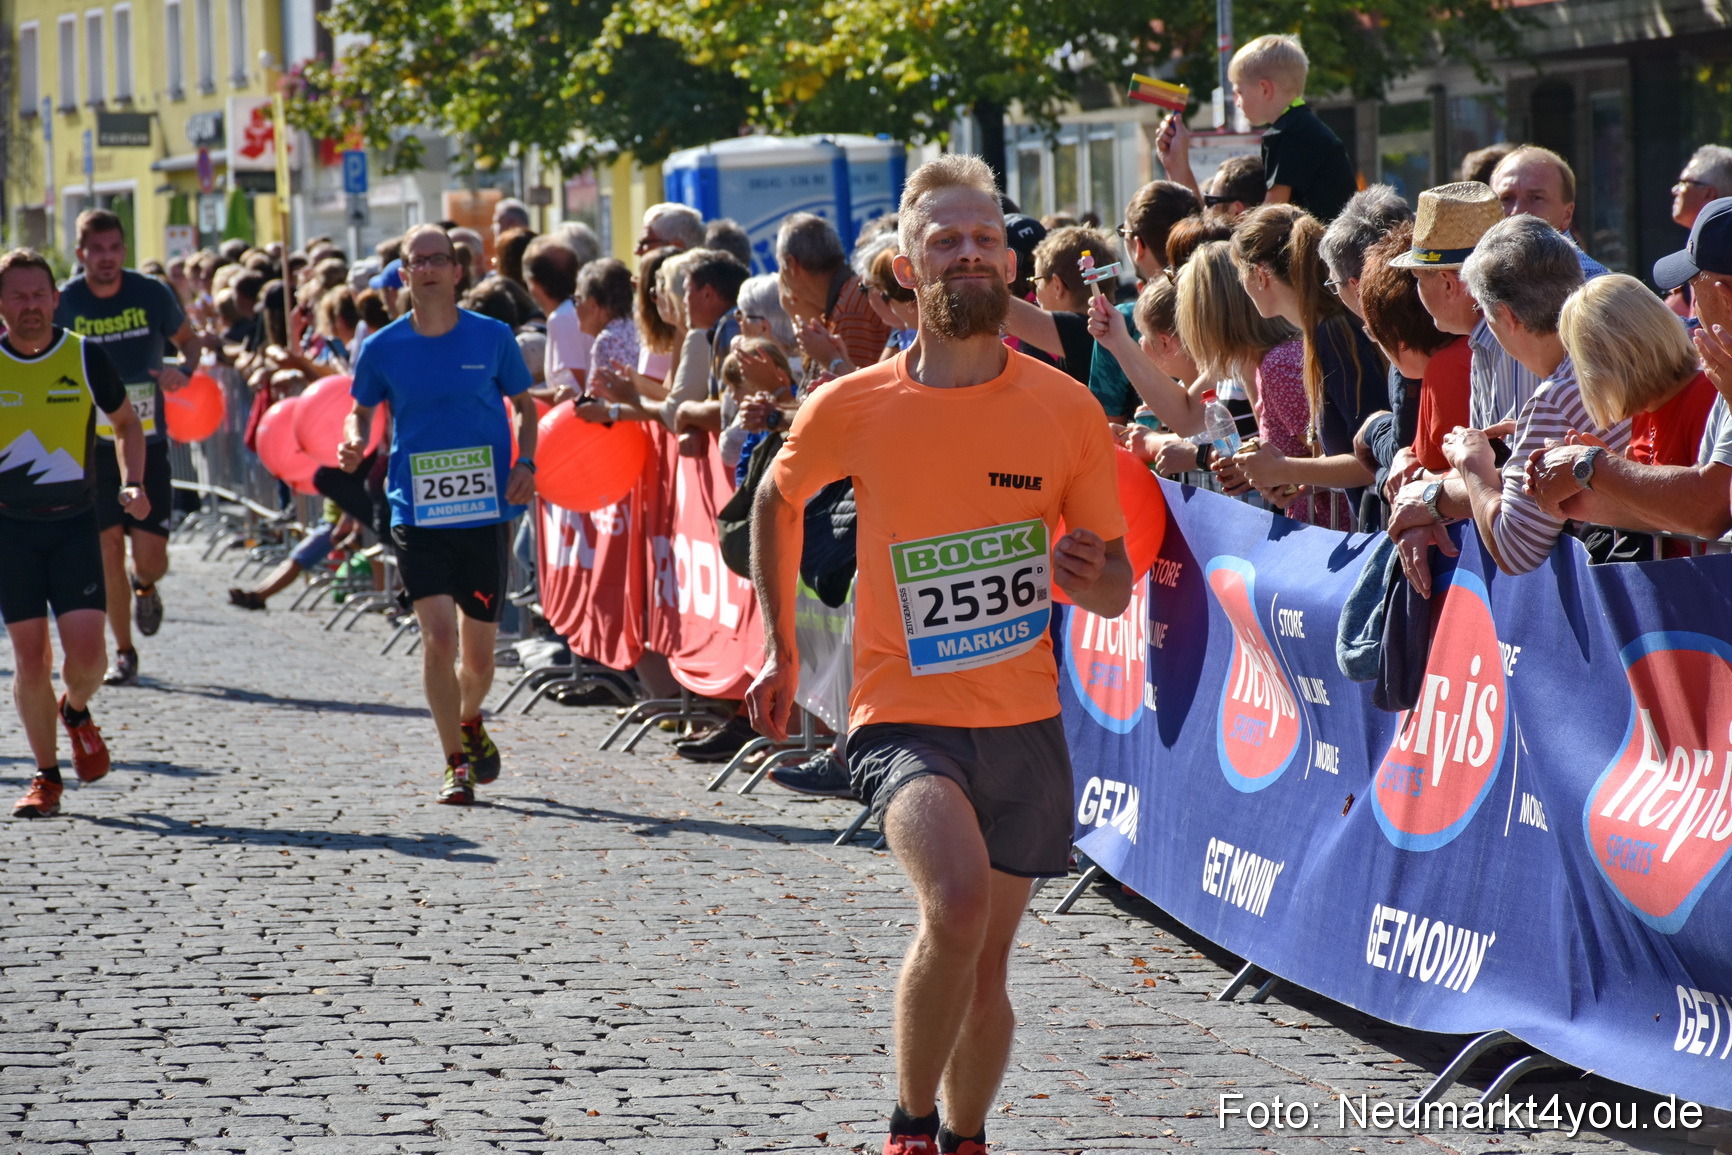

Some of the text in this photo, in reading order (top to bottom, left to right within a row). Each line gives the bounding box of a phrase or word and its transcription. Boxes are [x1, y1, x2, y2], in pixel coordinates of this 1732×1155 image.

[75, 307, 148, 336] CrossFit
[418, 451, 486, 471] BOCK
[423, 473, 486, 500] 2625
[989, 472, 1042, 491] THULE
[428, 501, 486, 517] ANDREAS
[904, 527, 1035, 577] BOCK
[918, 567, 1036, 628] 2536
[937, 621, 1030, 658] MARKUS
[1278, 608, 1306, 639] STORE
[1229, 714, 1268, 748] SPORTS
[1314, 740, 1340, 775] MOBILE
[1606, 834, 1659, 876] SPORTS
